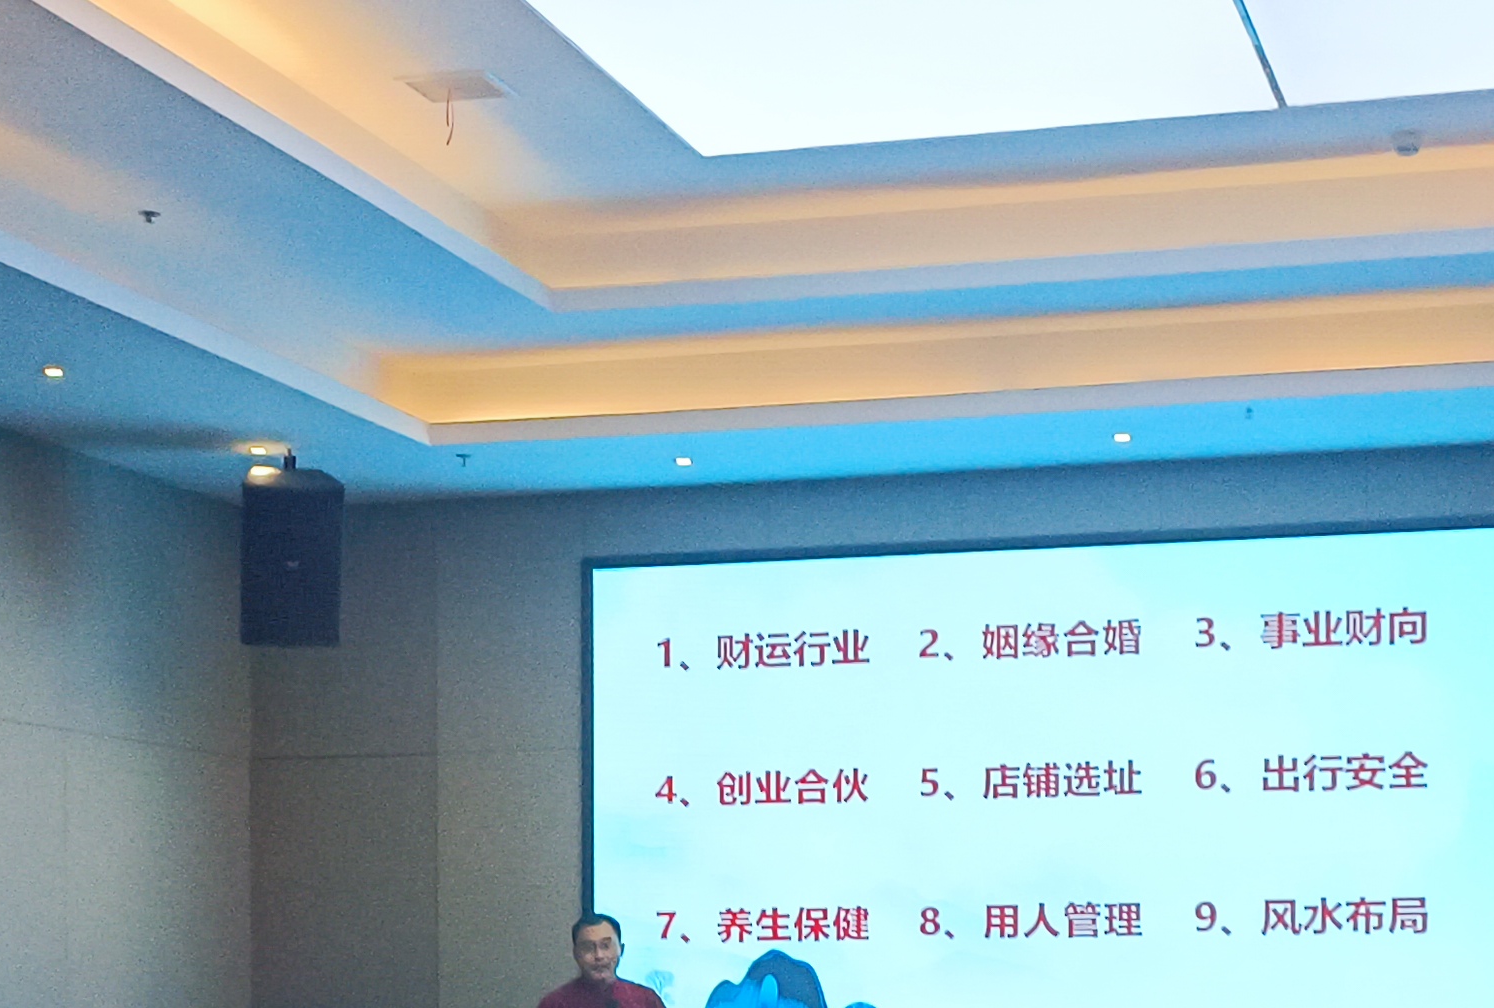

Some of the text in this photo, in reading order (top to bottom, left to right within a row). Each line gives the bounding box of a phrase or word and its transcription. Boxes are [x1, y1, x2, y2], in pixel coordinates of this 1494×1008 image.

[657, 607, 1427, 670] 1、财运行业 2、姻缘合婚 3、事业财向
[655, 752, 1428, 807] 4、创业合伙 5、店铺选址 6、出行安全
[657, 897, 1428, 944] 7、养生保健 8、用人管理 9、风水布局
